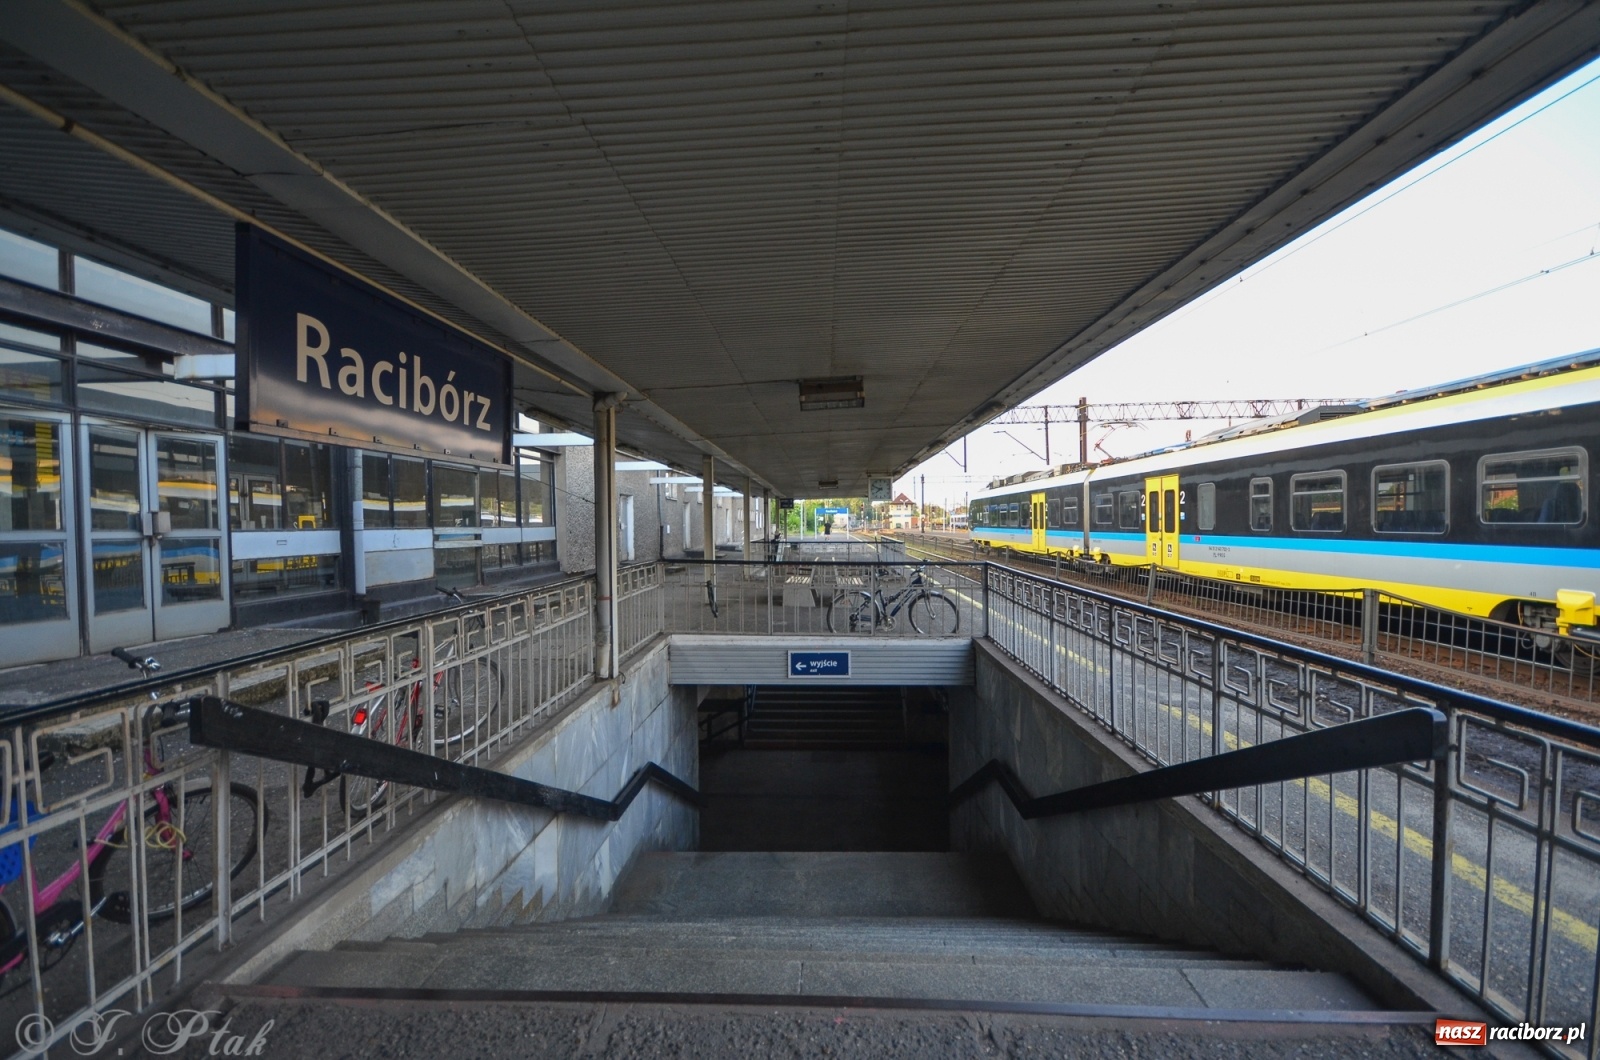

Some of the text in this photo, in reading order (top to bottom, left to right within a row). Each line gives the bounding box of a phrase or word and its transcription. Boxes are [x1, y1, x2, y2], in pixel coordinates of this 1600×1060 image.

[297, 312, 491, 431] Racibórz
[1140, 493, 1146, 507] 2
[1179, 490, 1186, 505] 2
[810, 660, 838, 669] wyjście
